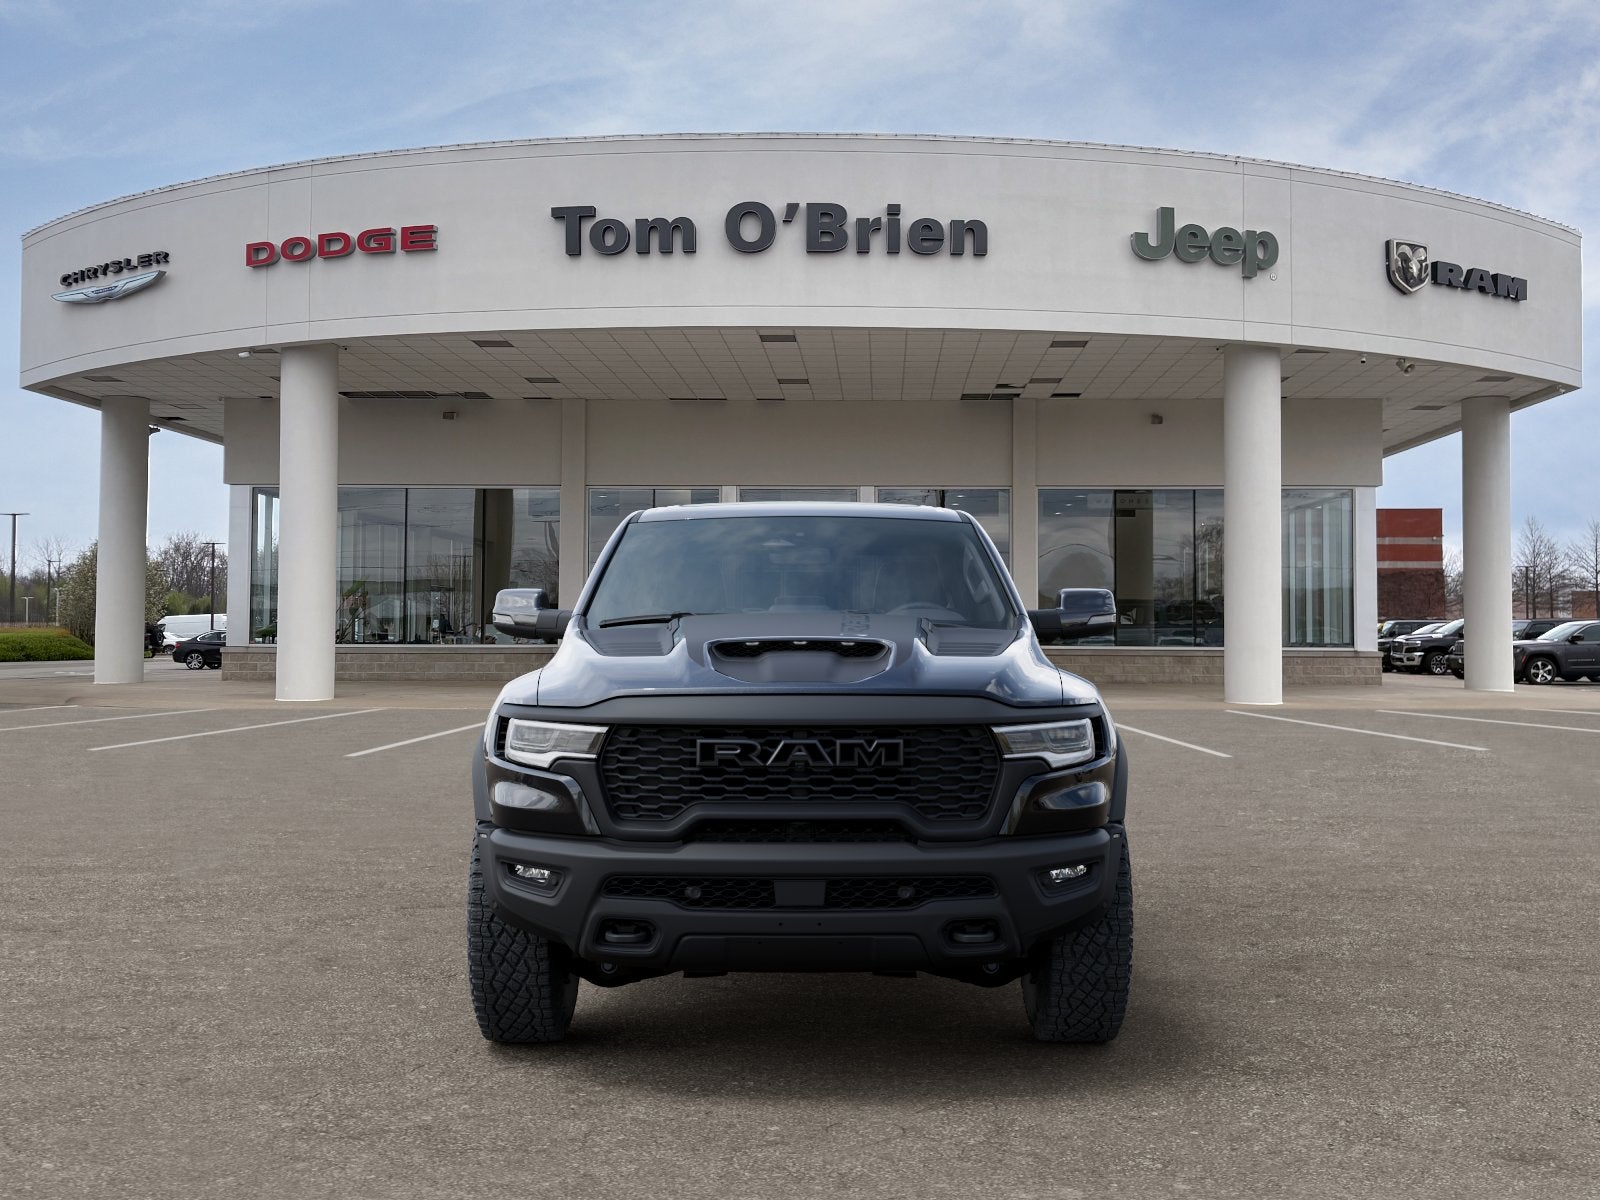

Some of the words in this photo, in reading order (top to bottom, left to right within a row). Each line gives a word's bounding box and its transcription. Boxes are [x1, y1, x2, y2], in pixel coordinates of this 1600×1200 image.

[245, 224, 438, 269] DODGE
[551, 205, 697, 256] Tom
[725, 201, 988, 256] O'Brien
[1130, 206, 1280, 279] Jeep
[59, 250, 170, 288] CHRYSLER
[1431, 260, 1528, 302] RAM
[696, 738, 904, 767] RAM
